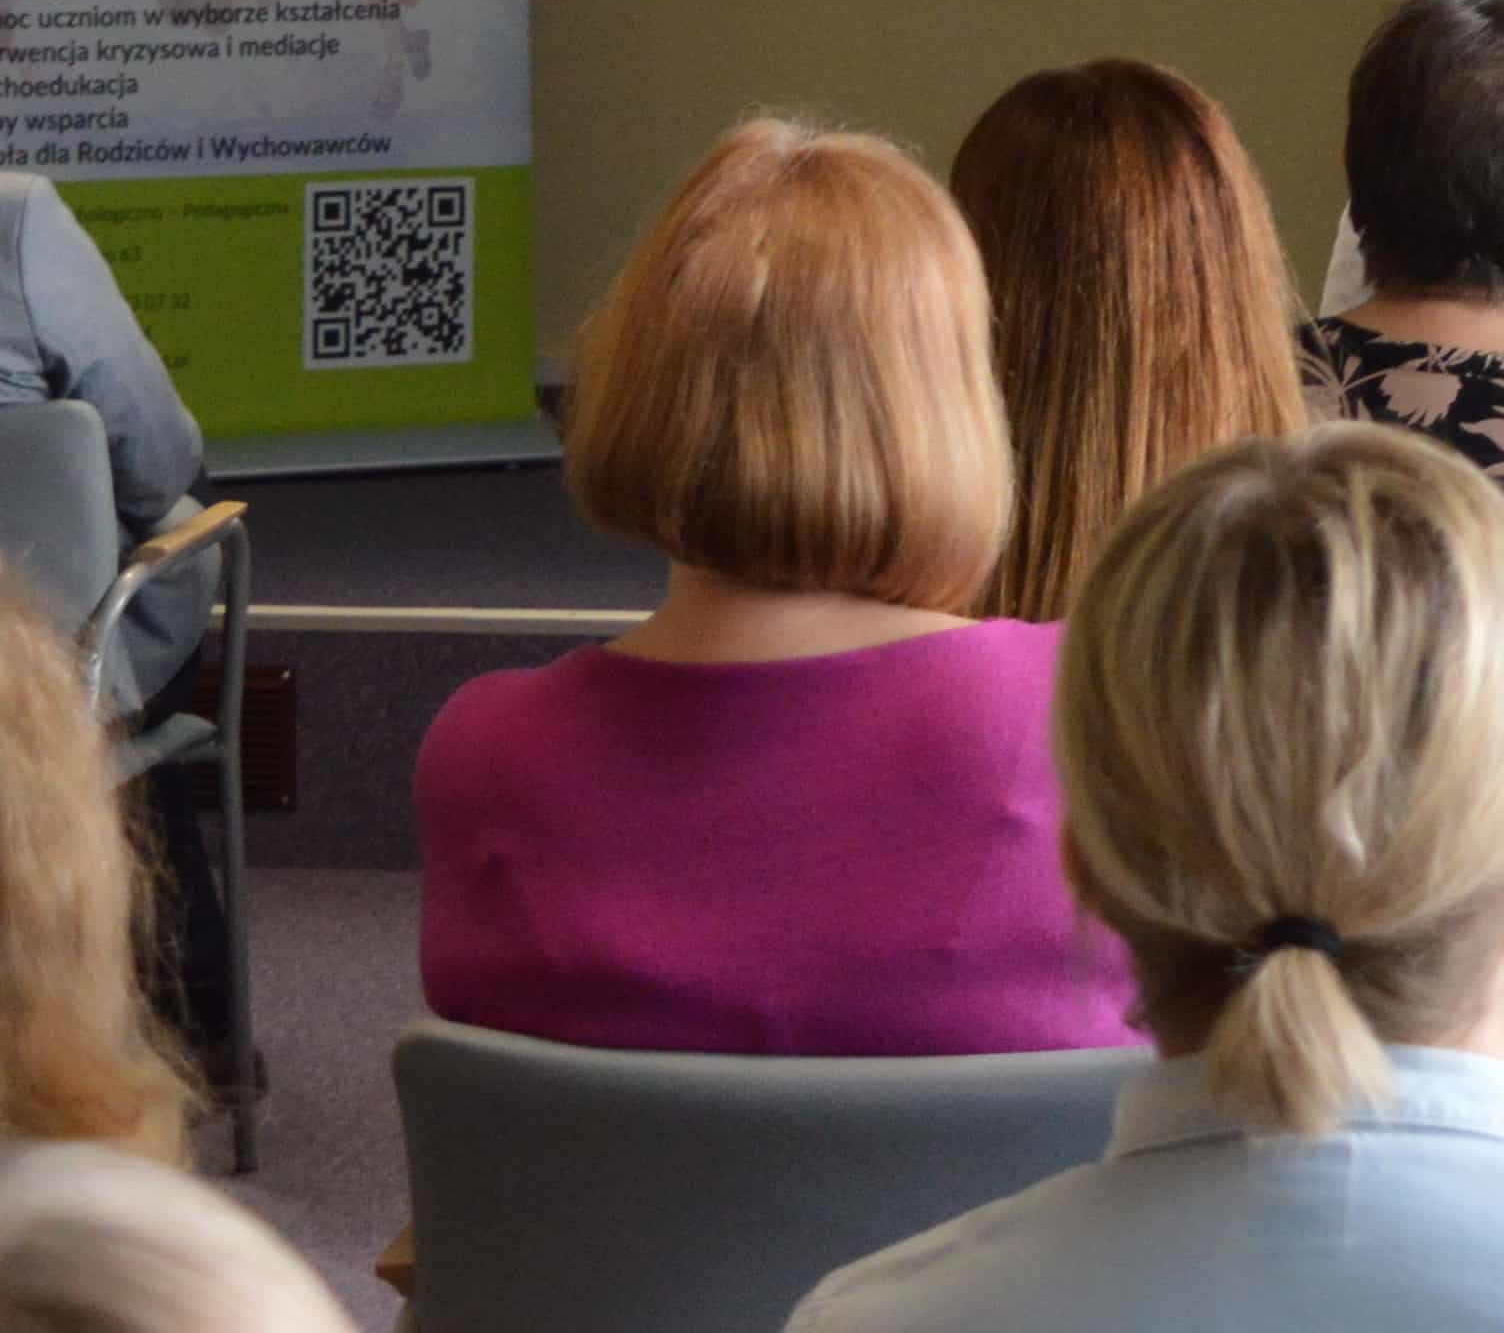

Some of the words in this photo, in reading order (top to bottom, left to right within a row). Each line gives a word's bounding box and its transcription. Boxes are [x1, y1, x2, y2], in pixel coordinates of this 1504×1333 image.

[37, 7, 137, 30] uczniom
[144, 12, 164, 27] w
[170, 3, 270, 30] wyborze
[275, 0, 401, 23] kształcenia
[96, 41, 220, 65] kryzysowa
[226, 38, 234, 58] i
[239, 33, 341, 62] mediacje
[23, 109, 129, 136] wsparcia
[35, 144, 72, 168] dla
[78, 140, 190, 167] Rodziców
[197, 139, 205, 162] i
[211, 132, 393, 162] Wychowawców
[183, 200, 290, 223] Pedagogiczna
